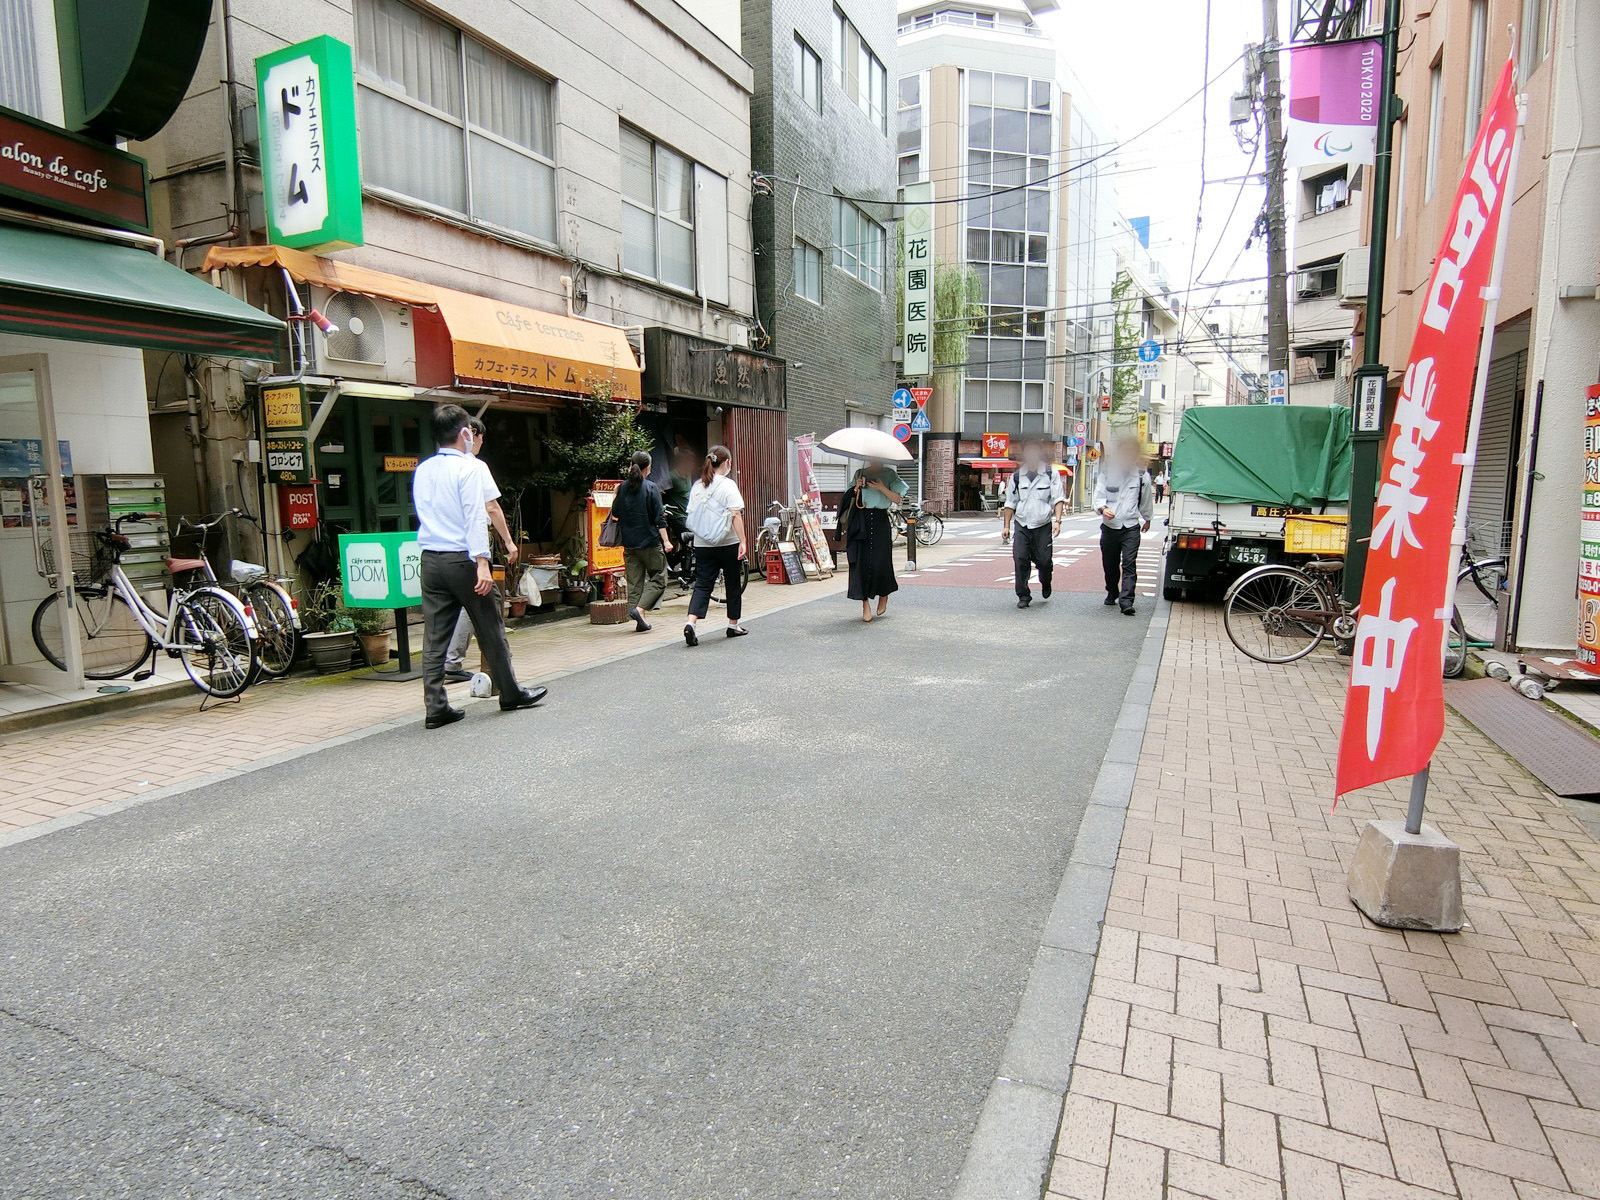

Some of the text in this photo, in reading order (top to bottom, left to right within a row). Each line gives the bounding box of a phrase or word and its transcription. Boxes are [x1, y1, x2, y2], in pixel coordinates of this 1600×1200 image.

[1360, 48, 1375, 121] TOKYO 2020
[305, 76, 321, 173] カフェテラス
[281, 85, 309, 206] ドム
[1, 142, 108, 192] alon de cafe
[907, 237, 928, 354] 花園医院
[537, 321, 585, 343] terrace
[270, 454, 302, 468] コロンビア
[288, 493, 314, 505] POST
[292, 516, 310, 525] DOM
[1237, 552, 1266, 564] 45-82
[350, 564, 386, 582] DOM
